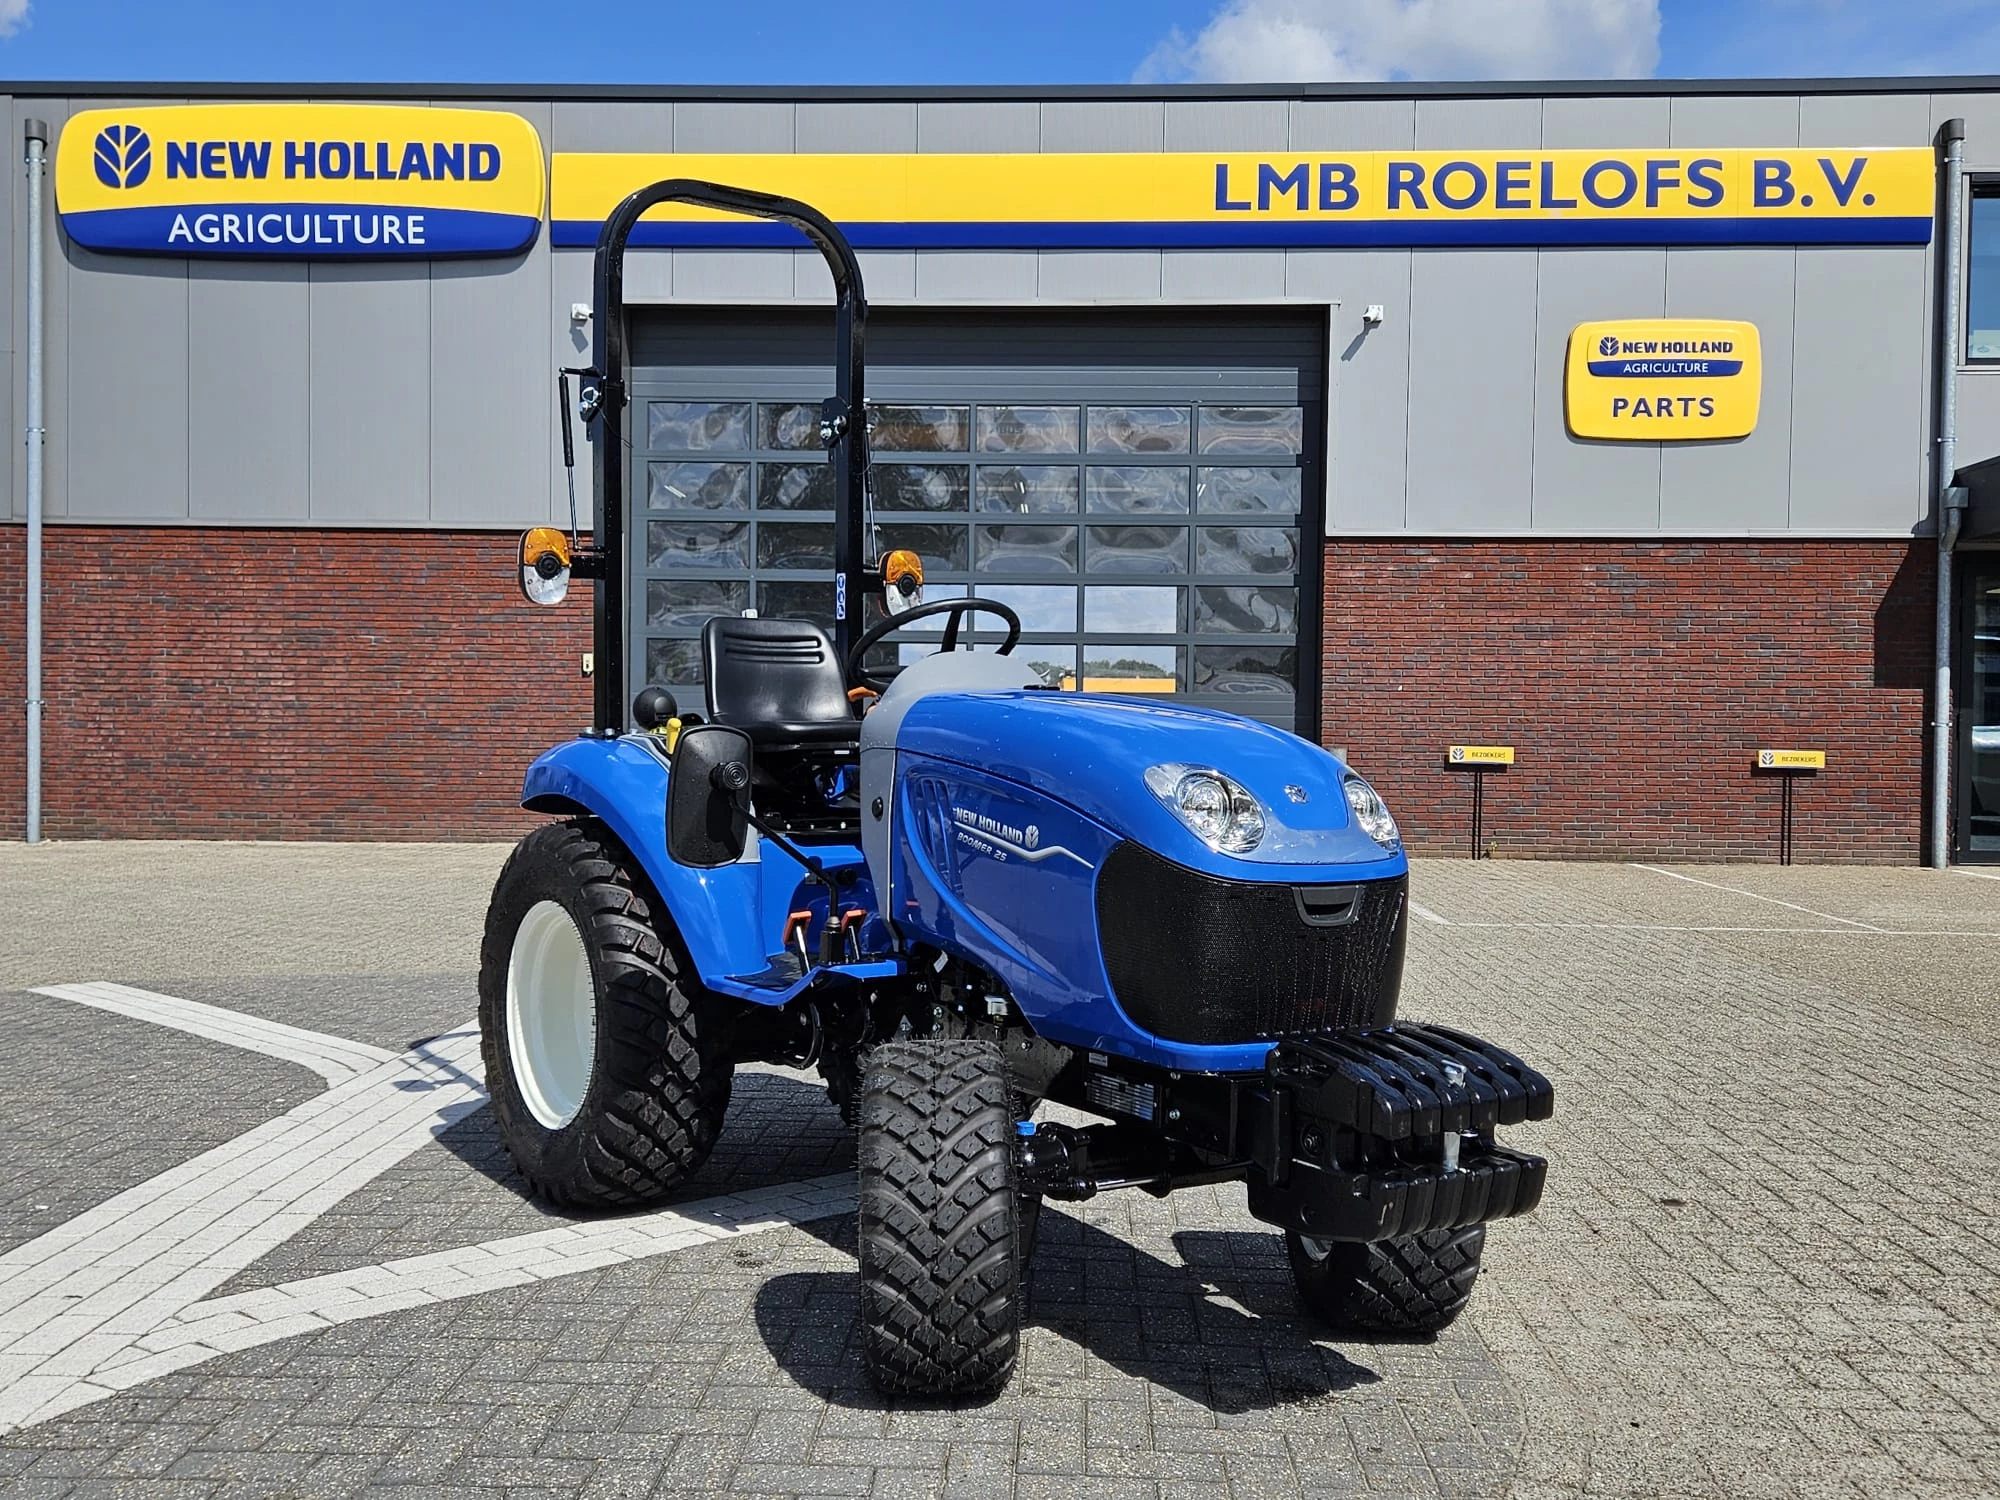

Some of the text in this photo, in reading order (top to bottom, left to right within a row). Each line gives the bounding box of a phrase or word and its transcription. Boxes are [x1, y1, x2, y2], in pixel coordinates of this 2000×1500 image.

[167, 141, 501, 181] NEW HOLLAND
[1214, 157, 1877, 211] LMB ROELOFS B.V.
[168, 213, 426, 245] AGRICULTURE
[1622, 341, 1733, 353] NEW HOLLAND
[1623, 362, 1709, 373] AGRICULTURE
[1612, 397, 1714, 418] PARTS
[955, 807, 1023, 844] NEW HOLLAND
[956, 832, 1008, 862] BOOMER 25
